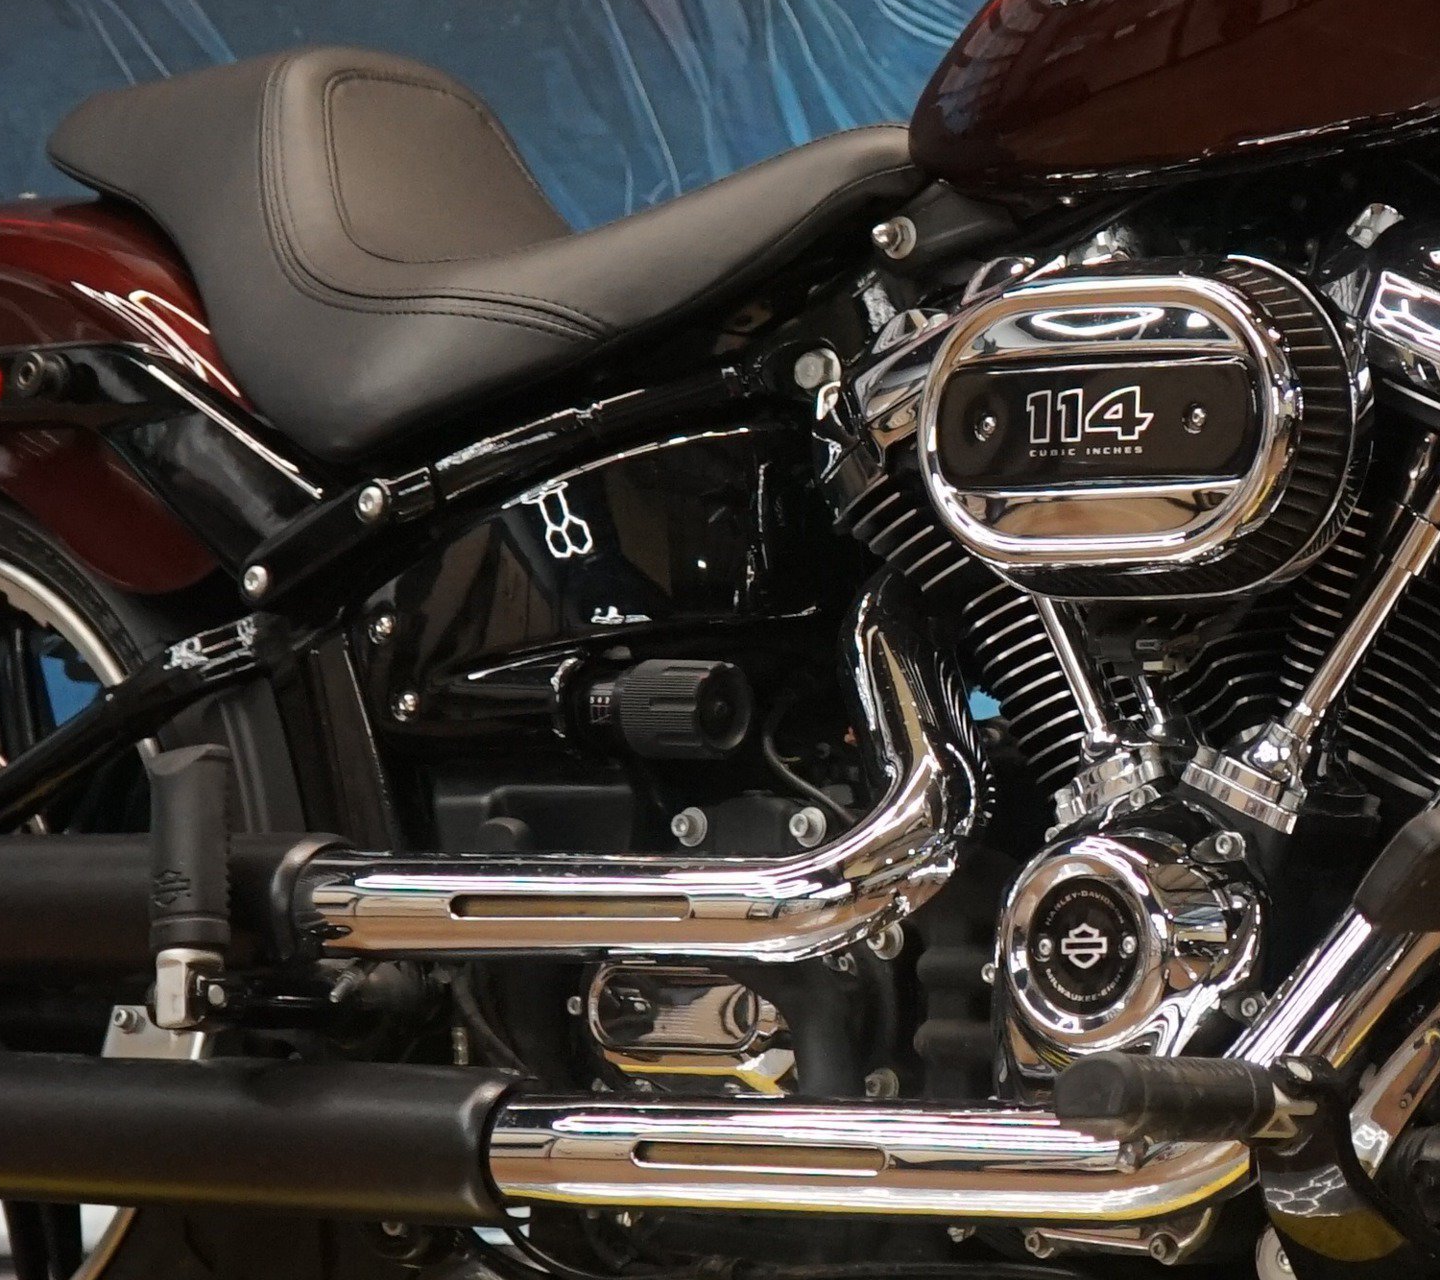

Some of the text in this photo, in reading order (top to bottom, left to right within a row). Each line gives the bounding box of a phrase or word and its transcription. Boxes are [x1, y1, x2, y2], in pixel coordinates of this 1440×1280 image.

[1026, 385, 1155, 444] 114
[1029, 444, 1144, 458] CUBIC INCHES
